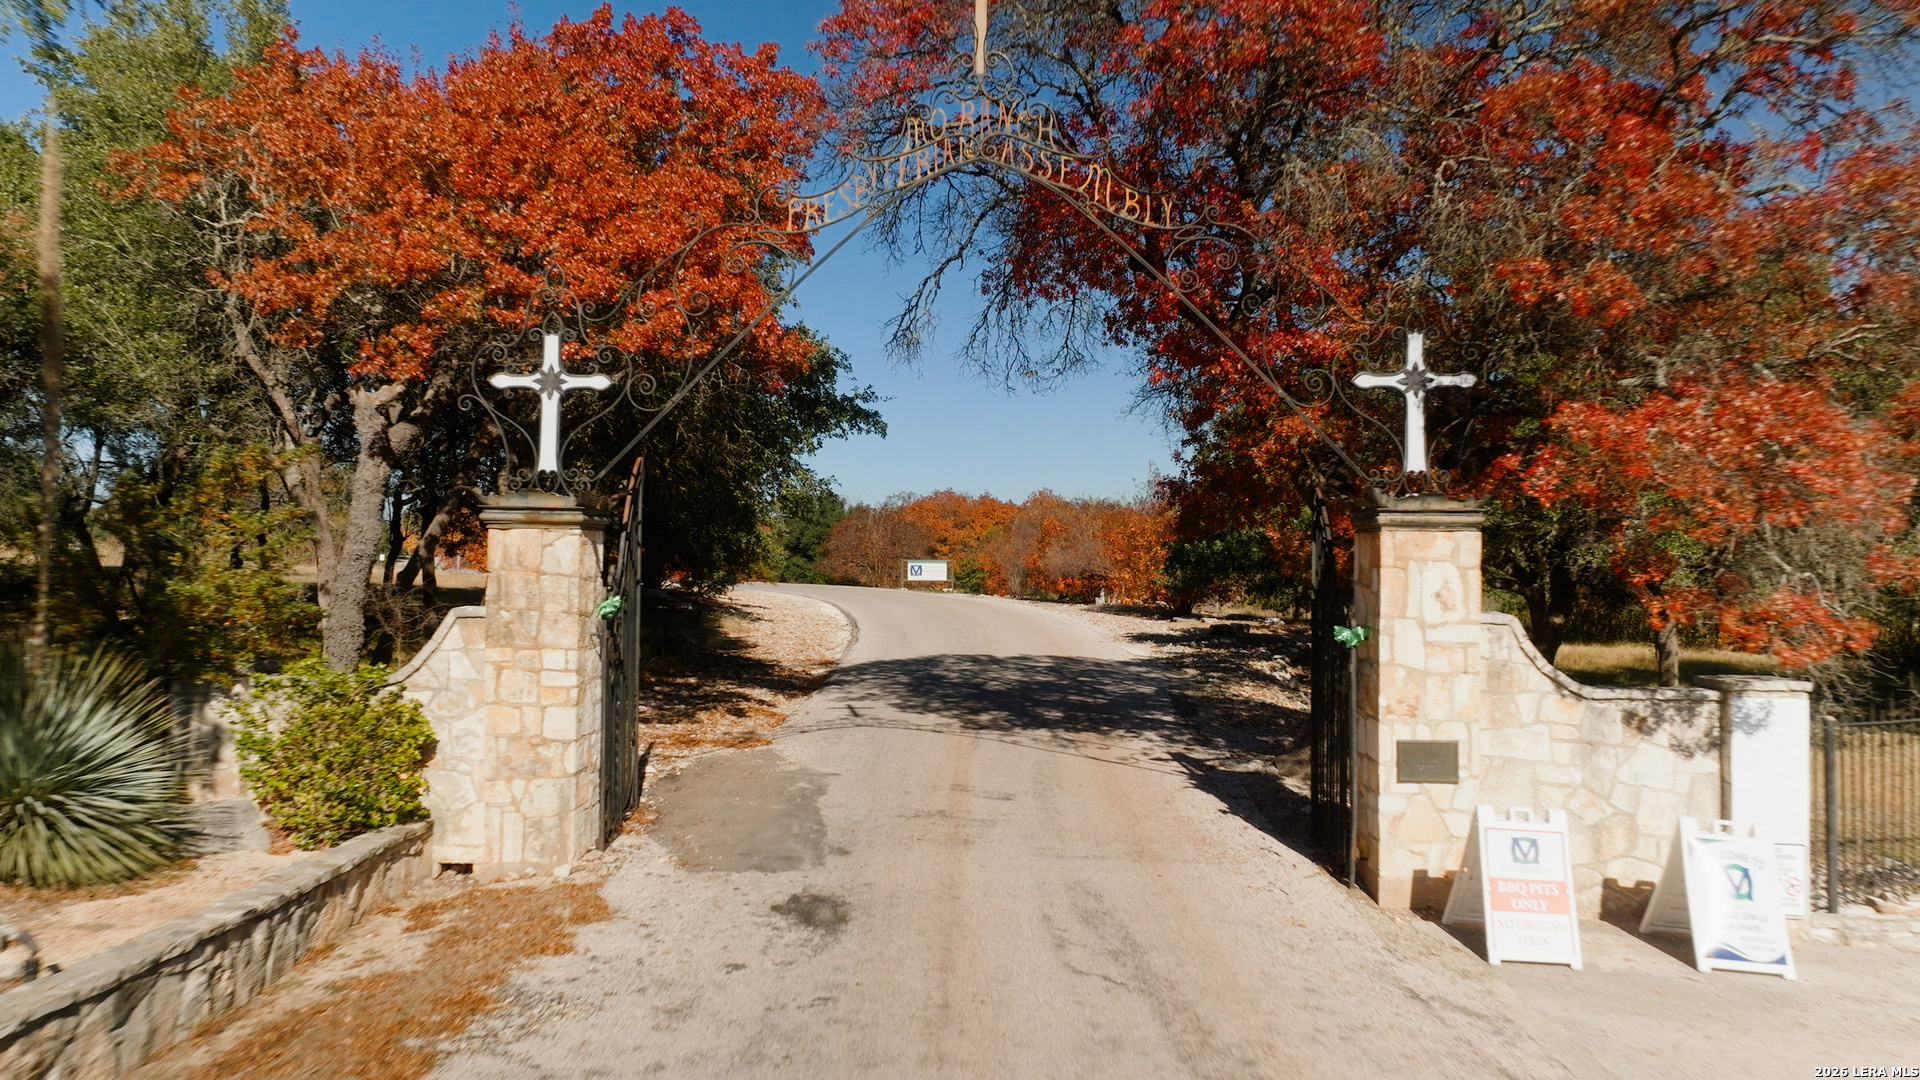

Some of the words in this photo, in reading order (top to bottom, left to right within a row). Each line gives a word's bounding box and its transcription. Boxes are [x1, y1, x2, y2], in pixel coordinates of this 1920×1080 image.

[902, 108, 947, 152] MO
[959, 98, 1058, 150] RANCH
[786, 136, 974, 232] PRESBYTERIAN
[1001, 137, 1173, 228] ASSEMBLY
[1497, 881, 1529, 897] BBQ
[1529, 882, 1560, 896] PITS
[1510, 898, 1549, 911] ONLY
[1496, 918, 1514, 930] NO
[1516, 919, 1568, 933] GROUND
[1517, 935, 1550, 947] FIRES
